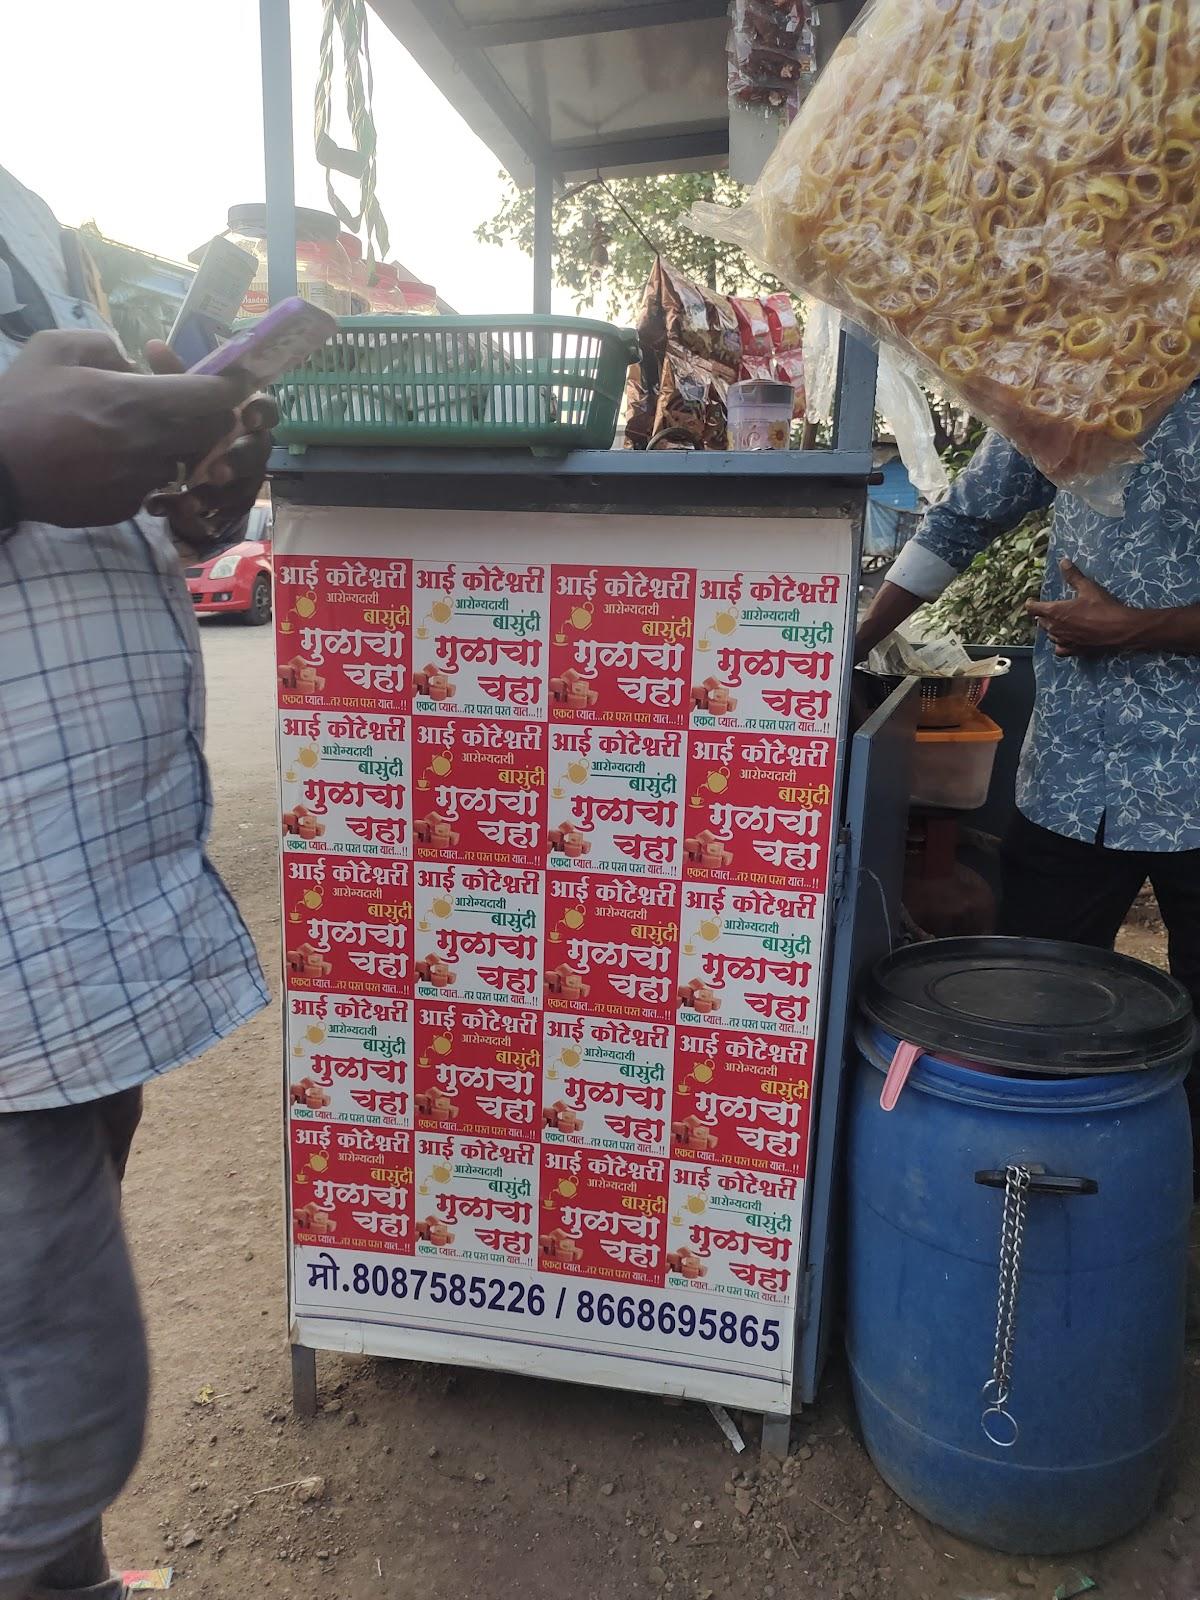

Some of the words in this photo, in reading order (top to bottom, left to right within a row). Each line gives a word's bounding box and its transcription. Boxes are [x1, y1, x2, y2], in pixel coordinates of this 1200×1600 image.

[280, 560, 319, 590] आई
[325, 561, 406, 589] कोटेश्वरी
[416, 564, 456, 595] आई
[462, 565, 545, 593] कोटेश्वरी
[556, 570, 598, 601] आई
[604, 571, 689, 600] कोटेश्वरी
[699, 572, 744, 606] आई
[749, 574, 841, 604] कोटेश्वरी
[327, 590, 378, 604] आरोग्यदायी
[455, 596, 509, 611] आरोग्यदायी
[604, 601, 659, 615] आरोग्यदायी
[363, 602, 410, 631] बासुंदी
[492, 609, 541, 637] बासुंदी
[642, 614, 692, 643] बासुंदी
[740, 607, 800, 622] आरोग्यदायी
[299, 627, 405, 666] गुळाचा
[781, 620, 834, 649] बासुंदी
[435, 635, 543, 674] गुळाचा
[573, 639, 684, 679] गुळाचा
[716, 648, 834, 688] गुळाचा
[343, 663, 406, 693] चहा
[478, 675, 542, 706] चहा
[618, 676, 684, 708] चहा
[282, 695, 304, 704] एकदा
[343, 697, 358, 707] परत
[360, 698, 376, 708] परत
[416, 701, 437, 712] एकदा
[477, 705, 493, 715] परत
[495, 706, 511, 716] परत
[761, 688, 832, 720] चहा
[283, 712, 321, 742] आई
[326, 714, 406, 742] कोटेश्वरी
[552, 710, 574, 720] एकदा
[616, 712, 632, 723] परत
[634, 713, 651, 723] परत
[694, 716, 716, 726] एकदा
[759, 719, 777, 730] परत
[779, 720, 796, 730] परत
[321, 743, 373, 757] आरोग्यदायी
[417, 721, 456, 750] आई
[462, 723, 541, 750] कोटेश्वरी
[552, 727, 593, 757] आई
[598, 729, 682, 757] कोटेश्वरी
[463, 750, 514, 764] आरोग्यदायी
[591, 759, 645, 774] आरोग्यदायी
[693, 736, 736, 766] आई
[741, 739, 828, 768] कोटेश्वरी
[357, 756, 404, 781] बासुंदी
[498, 762, 545, 790] बासुंदी
[741, 767, 796, 782] आरोग्यदायी
[303, 779, 406, 815] गुळाचा
[628, 772, 678, 798] बासुंदी
[779, 780, 829, 810] बासुंदी
[435, 784, 539, 822] गुळाचा
[570, 796, 678, 833] गुळाचा
[345, 816, 407, 845] चहा
[478, 820, 540, 849] चहा
[709, 802, 822, 841] गुळाचा
[613, 834, 677, 864] चहा
[753, 840, 821, 872] चहा
[288, 858, 326, 885] आई
[332, 860, 408, 886] कोटेश्वरी
[418, 865, 456, 893] आई
[461, 867, 540, 895] कोटेश्वरी
[686, 868, 708, 879] एकदा
[750, 874, 767, 884] परत
[769, 875, 786, 886] परत
[333, 885, 382, 899] आरोग्यदायी
[455, 895, 506, 909] आरोग्यदायी
[550, 876, 590, 904] आई
[596, 879, 675, 907] कोटेश्वरी
[684, 886, 727, 916] आई
[732, 889, 818, 920] कोटेश्वरी
[368, 897, 412, 924] बासुंदी
[490, 908, 537, 933] बासुंदी
[596, 905, 647, 920] आरोग्यदायी
[307, 918, 407, 953] गुळाचा
[631, 918, 678, 946] बासुंदी
[724, 918, 779, 934] आरोग्यदायी
[436, 929, 538, 964] गुळाचा
[567, 937, 671, 974] गुळाचा
[761, 933, 812, 959] बासुंदी
[349, 951, 409, 979] चहा
[701, 953, 812, 990] गुळाचा
[477, 966, 538, 994] चहा
[608, 974, 672, 1004] चहा
[292, 994, 329, 1021] आई
[333, 997, 409, 1023] कोटेश्वरी
[419, 1006, 456, 1031] आई
[462, 1009, 537, 1035] कोटेश्वरी
[744, 993, 810, 1023] चहा
[328, 1022, 377, 1036] आरोग्यदायी
[462, 1033, 511, 1047] आरोग्यदायी
[547, 1017, 586, 1044] आई
[590, 1020, 670, 1049] कोटेश्वरी
[362, 1035, 407, 1058] बासुंदी
[496, 1044, 540, 1071] बासुंदी
[584, 1046, 635, 1061] आरोग्यदायी
[680, 1033, 720, 1059] आई
[726, 1036, 807, 1065] कोटेश्वरी
[310, 1054, 408, 1087] गुळाचा
[436, 1062, 534, 1097] गुळाचा
[619, 1061, 666, 1084] बासुंदी
[725, 1061, 777, 1077] आरोग्यदायी
[350, 1089, 409, 1116] चहा
[564, 1078, 666, 1112] गुळाचा
[761, 1074, 809, 1102] बासुंदी
[476, 1096, 535, 1124] चहा
[695, 1091, 802, 1127] गुळाचा
[295, 1125, 331, 1150] आई
[336, 1128, 409, 1154] कोटेश्वरी
[604, 1115, 665, 1143] चहा
[736, 1127, 801, 1158] चहा
[338, 1151, 384, 1165] आरोग्यदायी
[418, 1136, 455, 1161] आई
[459, 1139, 535, 1165] कोटेश्वरी
[371, 1162, 413, 1187] बासुंदी
[454, 1163, 502, 1178] आरोग्यदायी
[544, 1150, 583, 1175] आई
[588, 1155, 664, 1182] कोटेश्वरी
[313, 1179, 408, 1212] गुळाचा
[487, 1177, 532, 1199] बासुंदी
[588, 1178, 637, 1192] आरोग्यदायी
[671, 1165, 712, 1192] आई
[716, 1170, 798, 1201] कोटेश्वरी
[436, 1193, 533, 1226] गुळाचा
[622, 1190, 666, 1216] बासुंदी
[709, 1195, 762, 1212] आरोग्यदायी
[352, 1211, 409, 1238] चहा
[560, 1205, 660, 1240] गुळाचा
[745, 1212, 793, 1235] बासुंदी
[474, 1228, 533, 1255] चहा
[600, 1240, 660, 1268] चहा
[689, 1225, 792, 1262] गुळाचा
[729, 1263, 790, 1292] चहा
[556, 1287, 567, 1319] /
[577, 1291, 780, 1352] 8668695865
